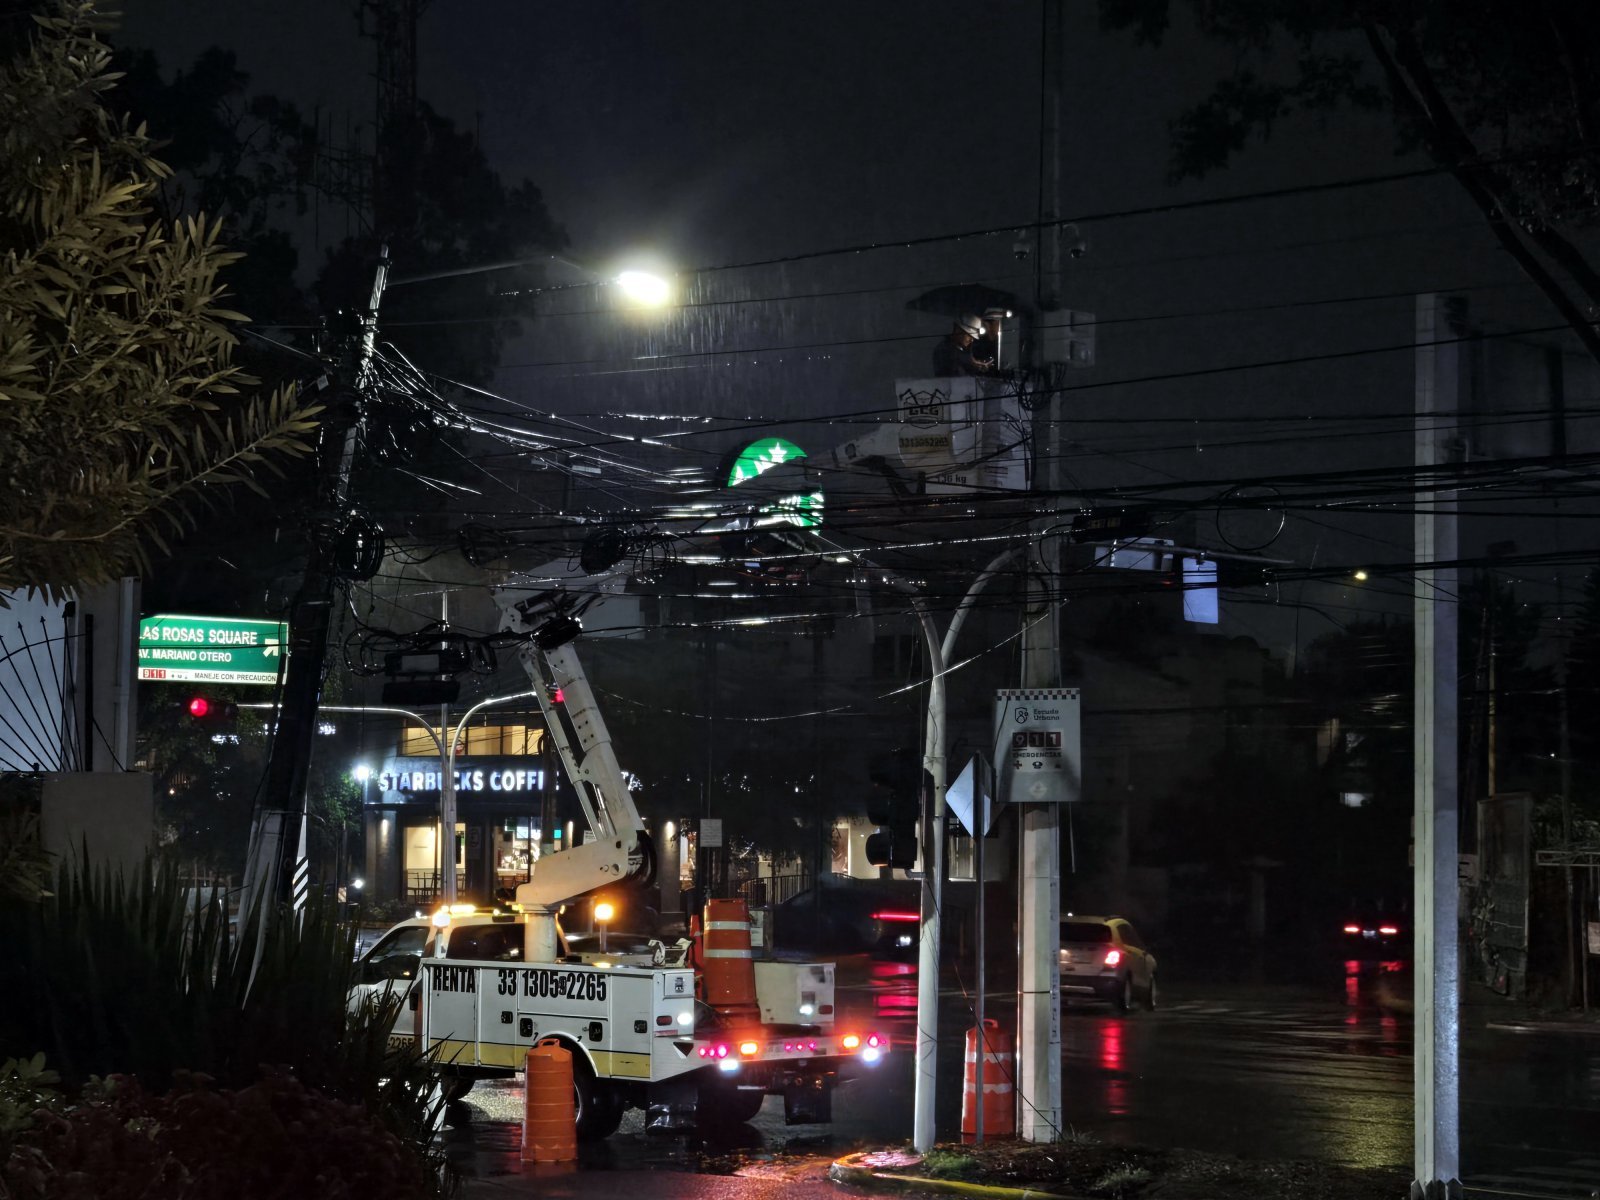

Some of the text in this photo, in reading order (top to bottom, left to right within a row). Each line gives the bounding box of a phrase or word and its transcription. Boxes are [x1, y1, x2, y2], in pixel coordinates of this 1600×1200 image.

[162, 627, 204, 643] ROSAS
[208, 629, 258, 645] SQUARE
[152, 649, 197, 661] MARIANO
[199, 651, 232, 663] OTERO
[143, 668, 166, 679] 911
[194, 672, 220, 680] MANEJE
[220, 673, 235, 681] CON
[1014, 732, 1059, 747] 911
[489, 770, 560, 791] COFF
[433, 966, 476, 993] RENTA
[498, 969, 517, 996] 33
